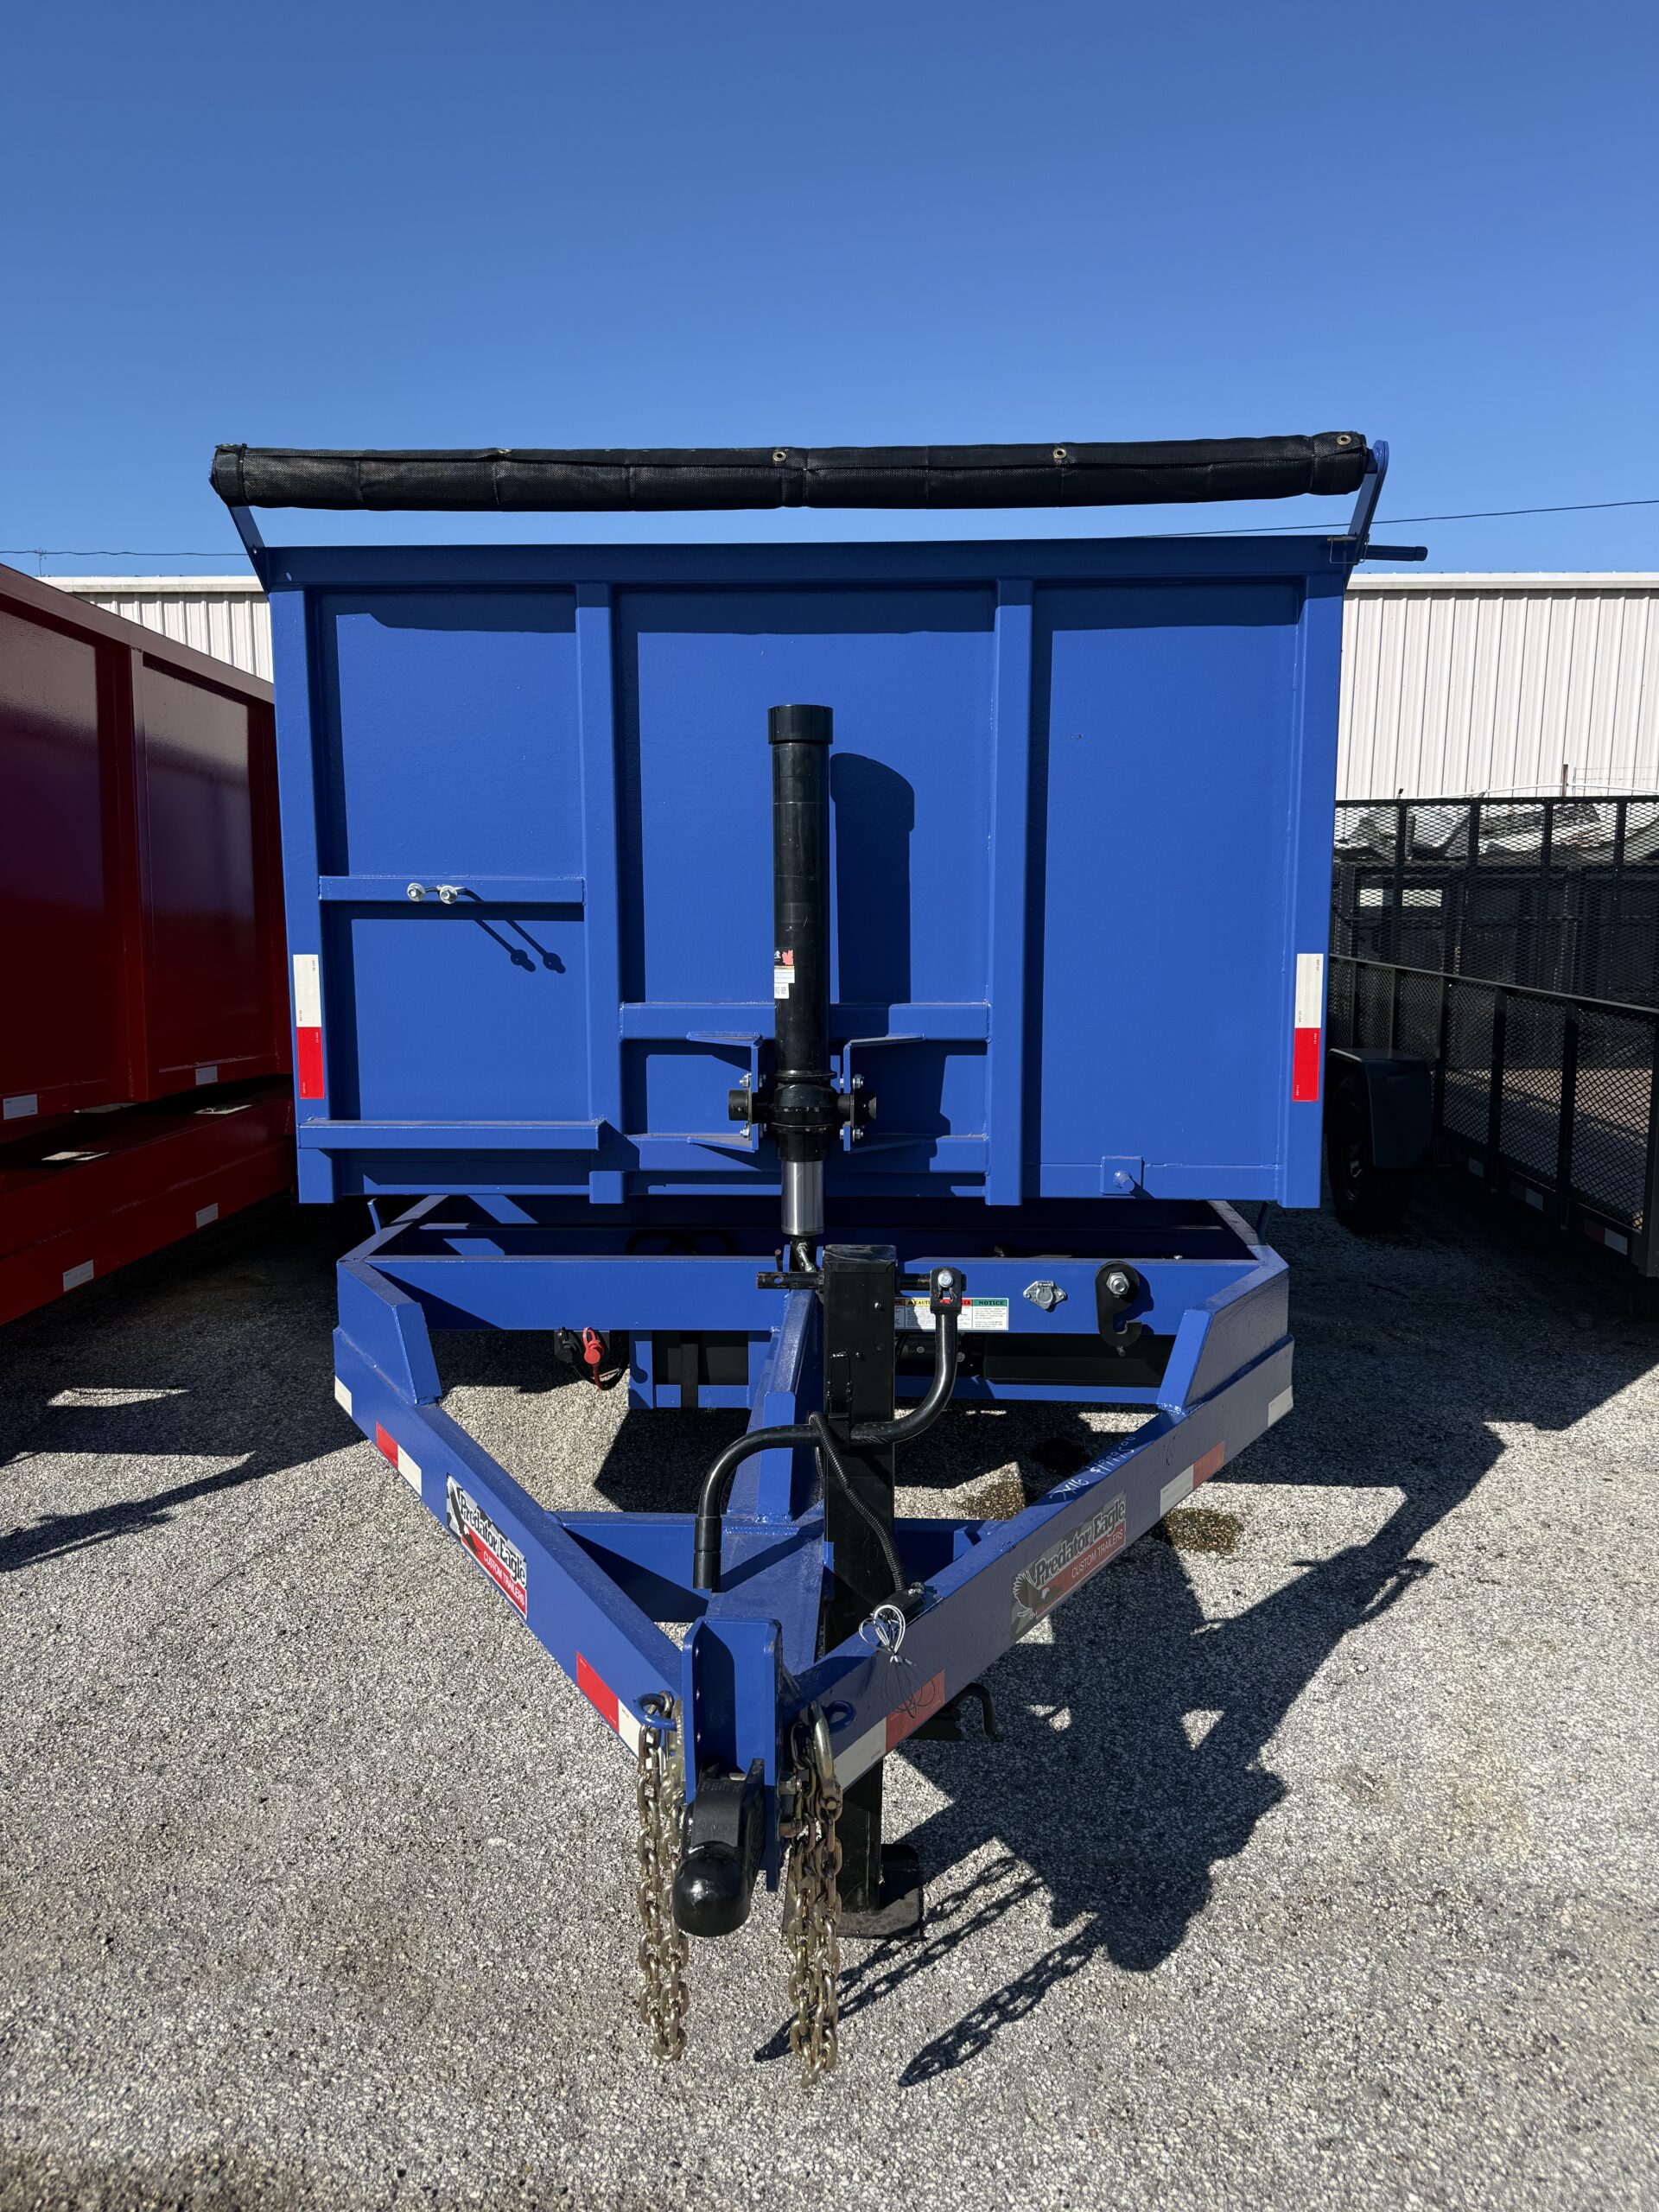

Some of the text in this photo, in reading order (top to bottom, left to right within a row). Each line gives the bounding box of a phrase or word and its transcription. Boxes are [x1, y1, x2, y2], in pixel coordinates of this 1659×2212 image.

[460, 1491, 525, 1586] Predator Eagle
[1036, 1500, 1126, 1585] Predator Eagle
[1071, 1529, 1123, 1579] CUSTOM TRAILERS
[483, 1551, 525, 1606] CUSTOM TRAILERS
